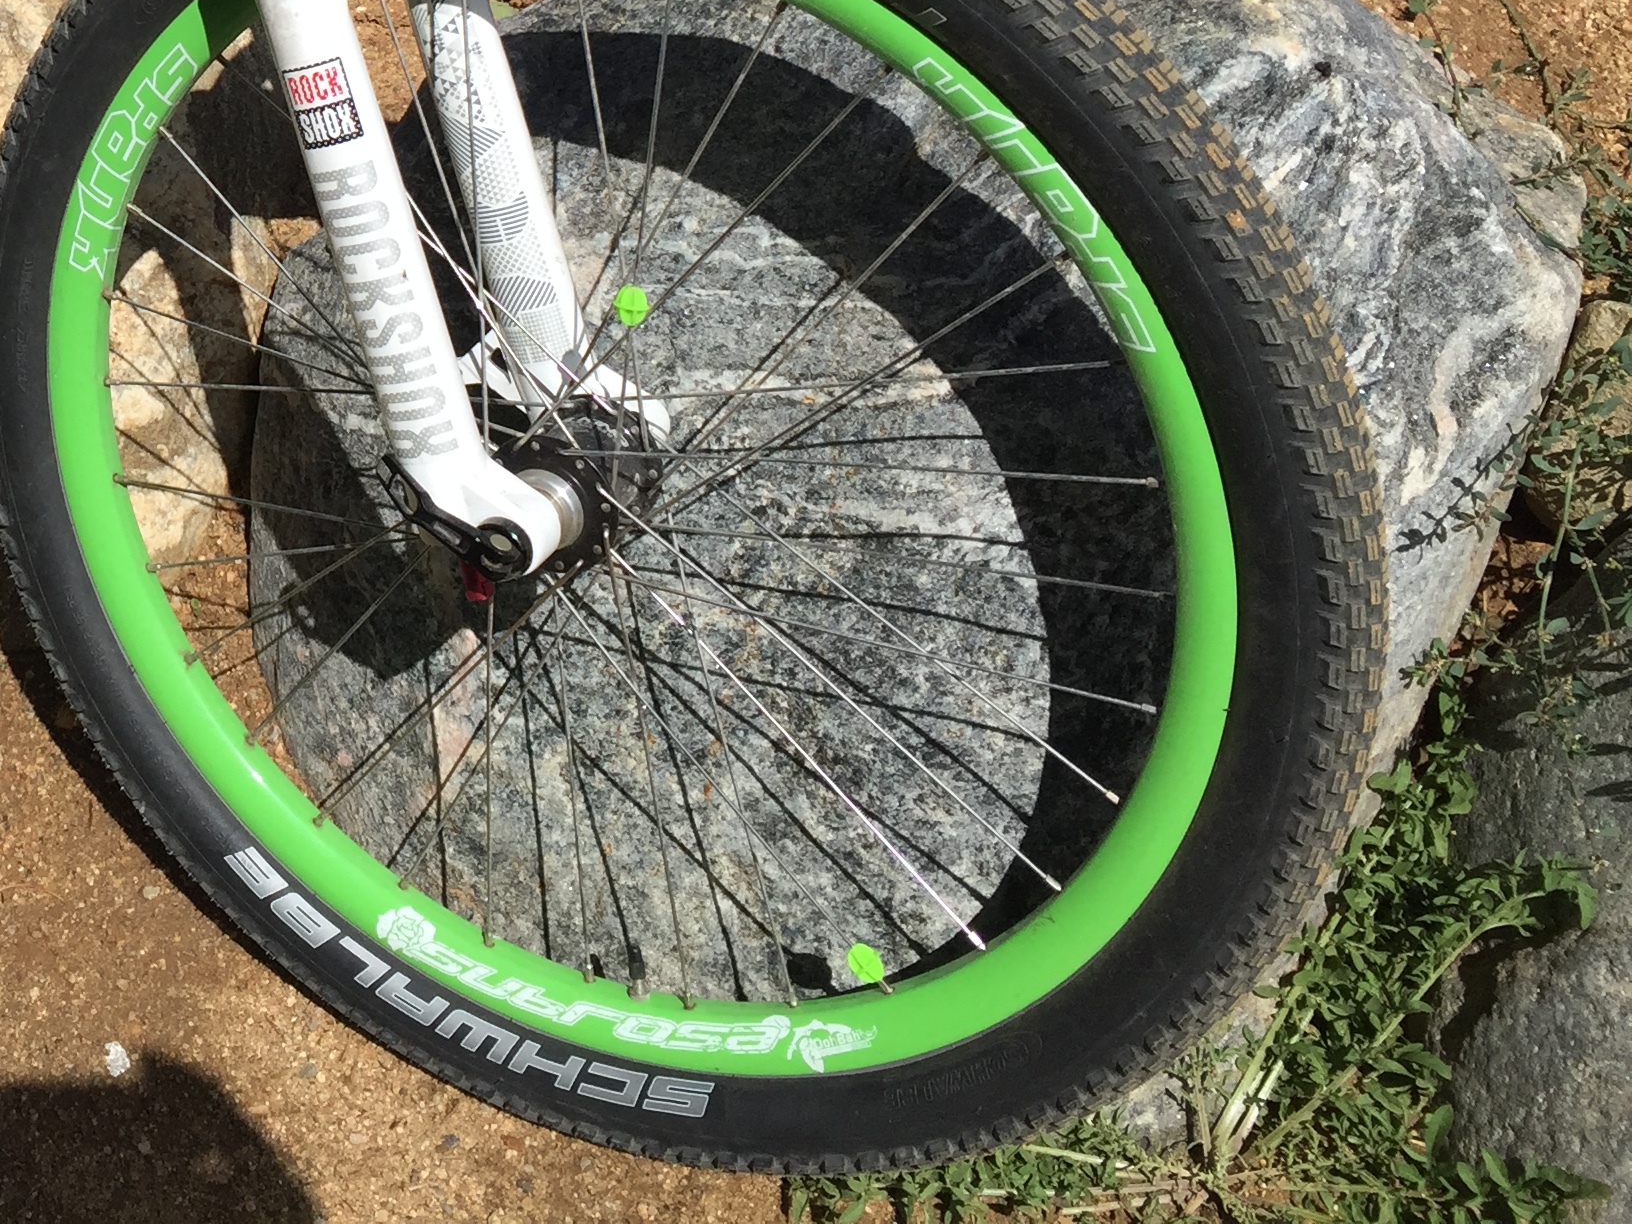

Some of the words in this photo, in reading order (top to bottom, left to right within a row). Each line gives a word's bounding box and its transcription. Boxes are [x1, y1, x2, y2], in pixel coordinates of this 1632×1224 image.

[288, 68, 344, 106] ROCK
[298, 103, 356, 143] SHOX
[313, 159, 459, 461] ROCKSHOX
[224, 845, 716, 1119] SCHWALBE
